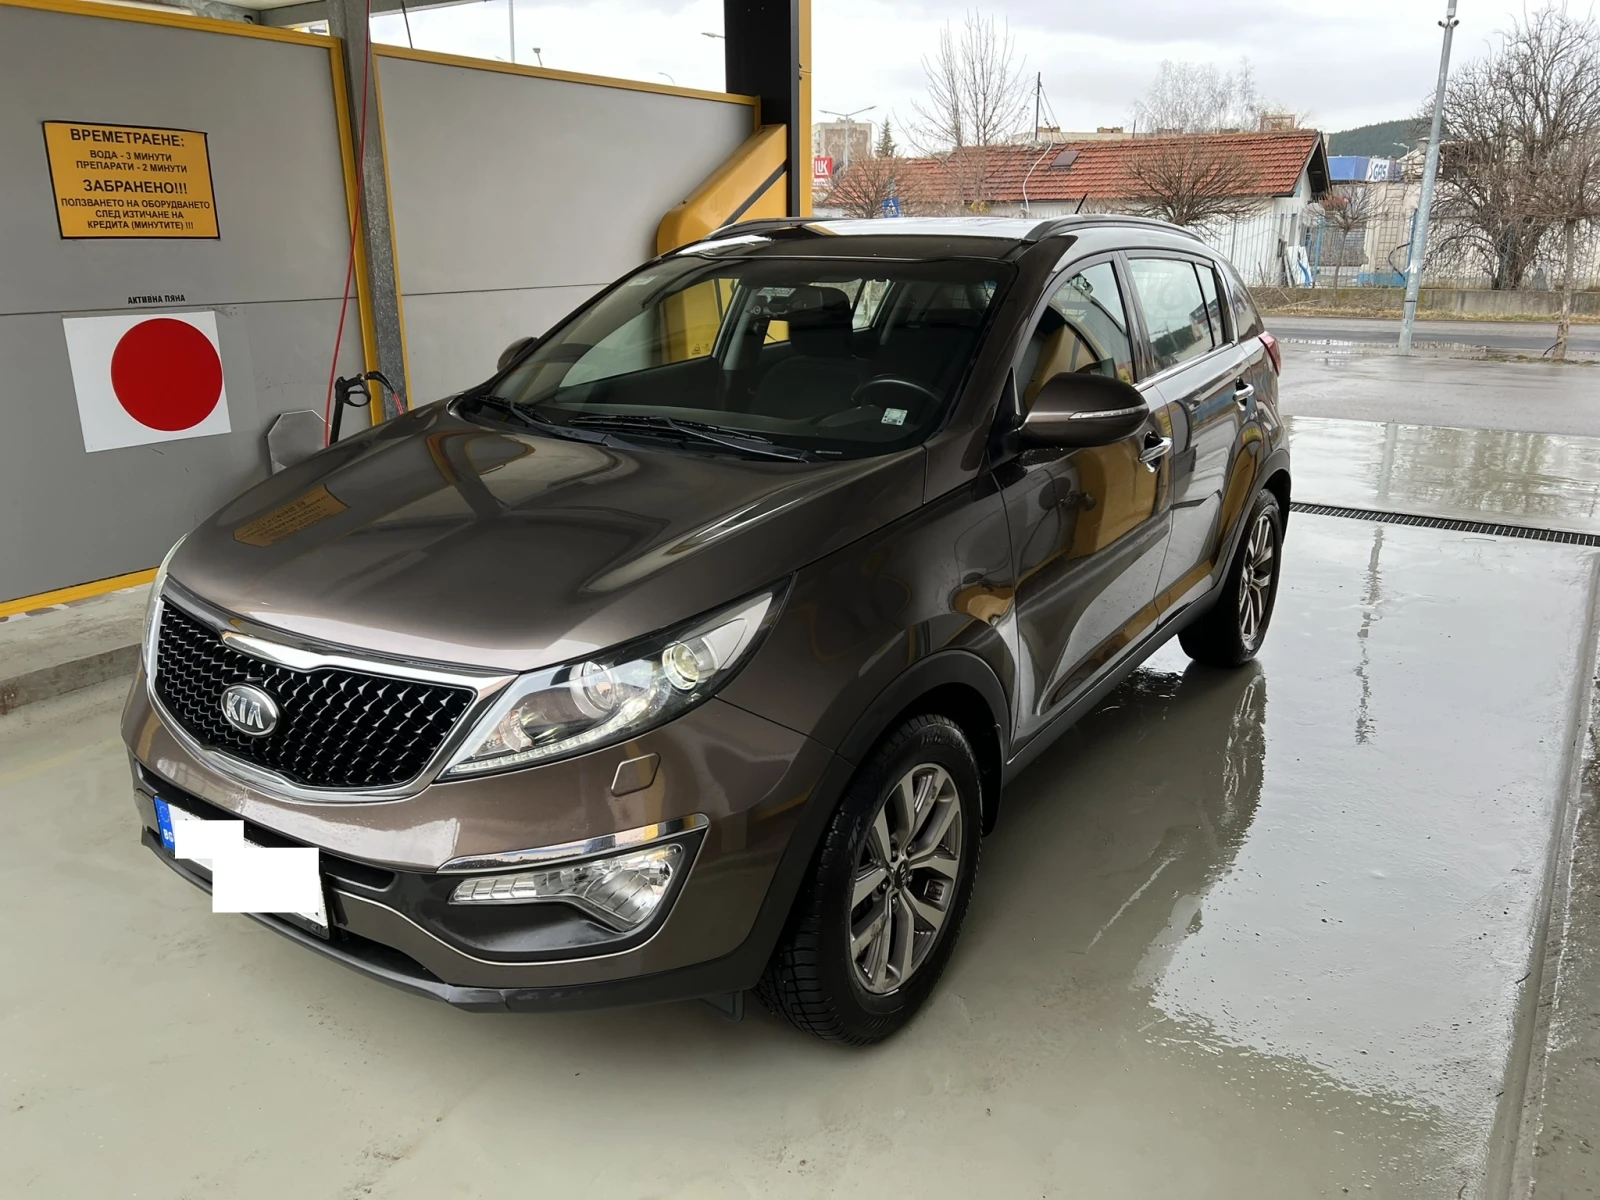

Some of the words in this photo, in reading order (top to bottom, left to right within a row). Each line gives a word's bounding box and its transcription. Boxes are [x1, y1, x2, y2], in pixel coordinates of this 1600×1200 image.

[70, 128, 185, 147] ВРЕМЕТРАЕНЕ:
[90, 150, 118, 159] ВОДА
[126, 151, 131, 160] 3
[134, 152, 172, 162] МИНУТИ
[76, 160, 135, 171] ПРЕПАРАТИ
[142, 163, 148, 171] 2
[150, 164, 187, 173] МИНУТИ
[83, 179, 188, 194] ЗАБРАНЕНО!!!
[61, 198, 124, 208] ПОЛЗВАНЕТО
[127, 199, 139, 208] НА
[142, 200, 211, 210] ОБОРУДВАНЕТО
[95, 210, 121, 219] СЛЕД
[123, 210, 169, 219] ИЗТИЧАНЕ
[172, 211, 184, 219] НА
[87, 220, 129, 230] КРЕДИТА
[131, 220, 183, 231] (МИНУТИТЕ)
[186, 221, 194, 230] !!!
[128, 295, 163, 304] АКТИВНА
[164, 294, 186, 303] ПЯНА
[226, 692, 264, 729] KIA
[163, 828, 175, 842] BG
